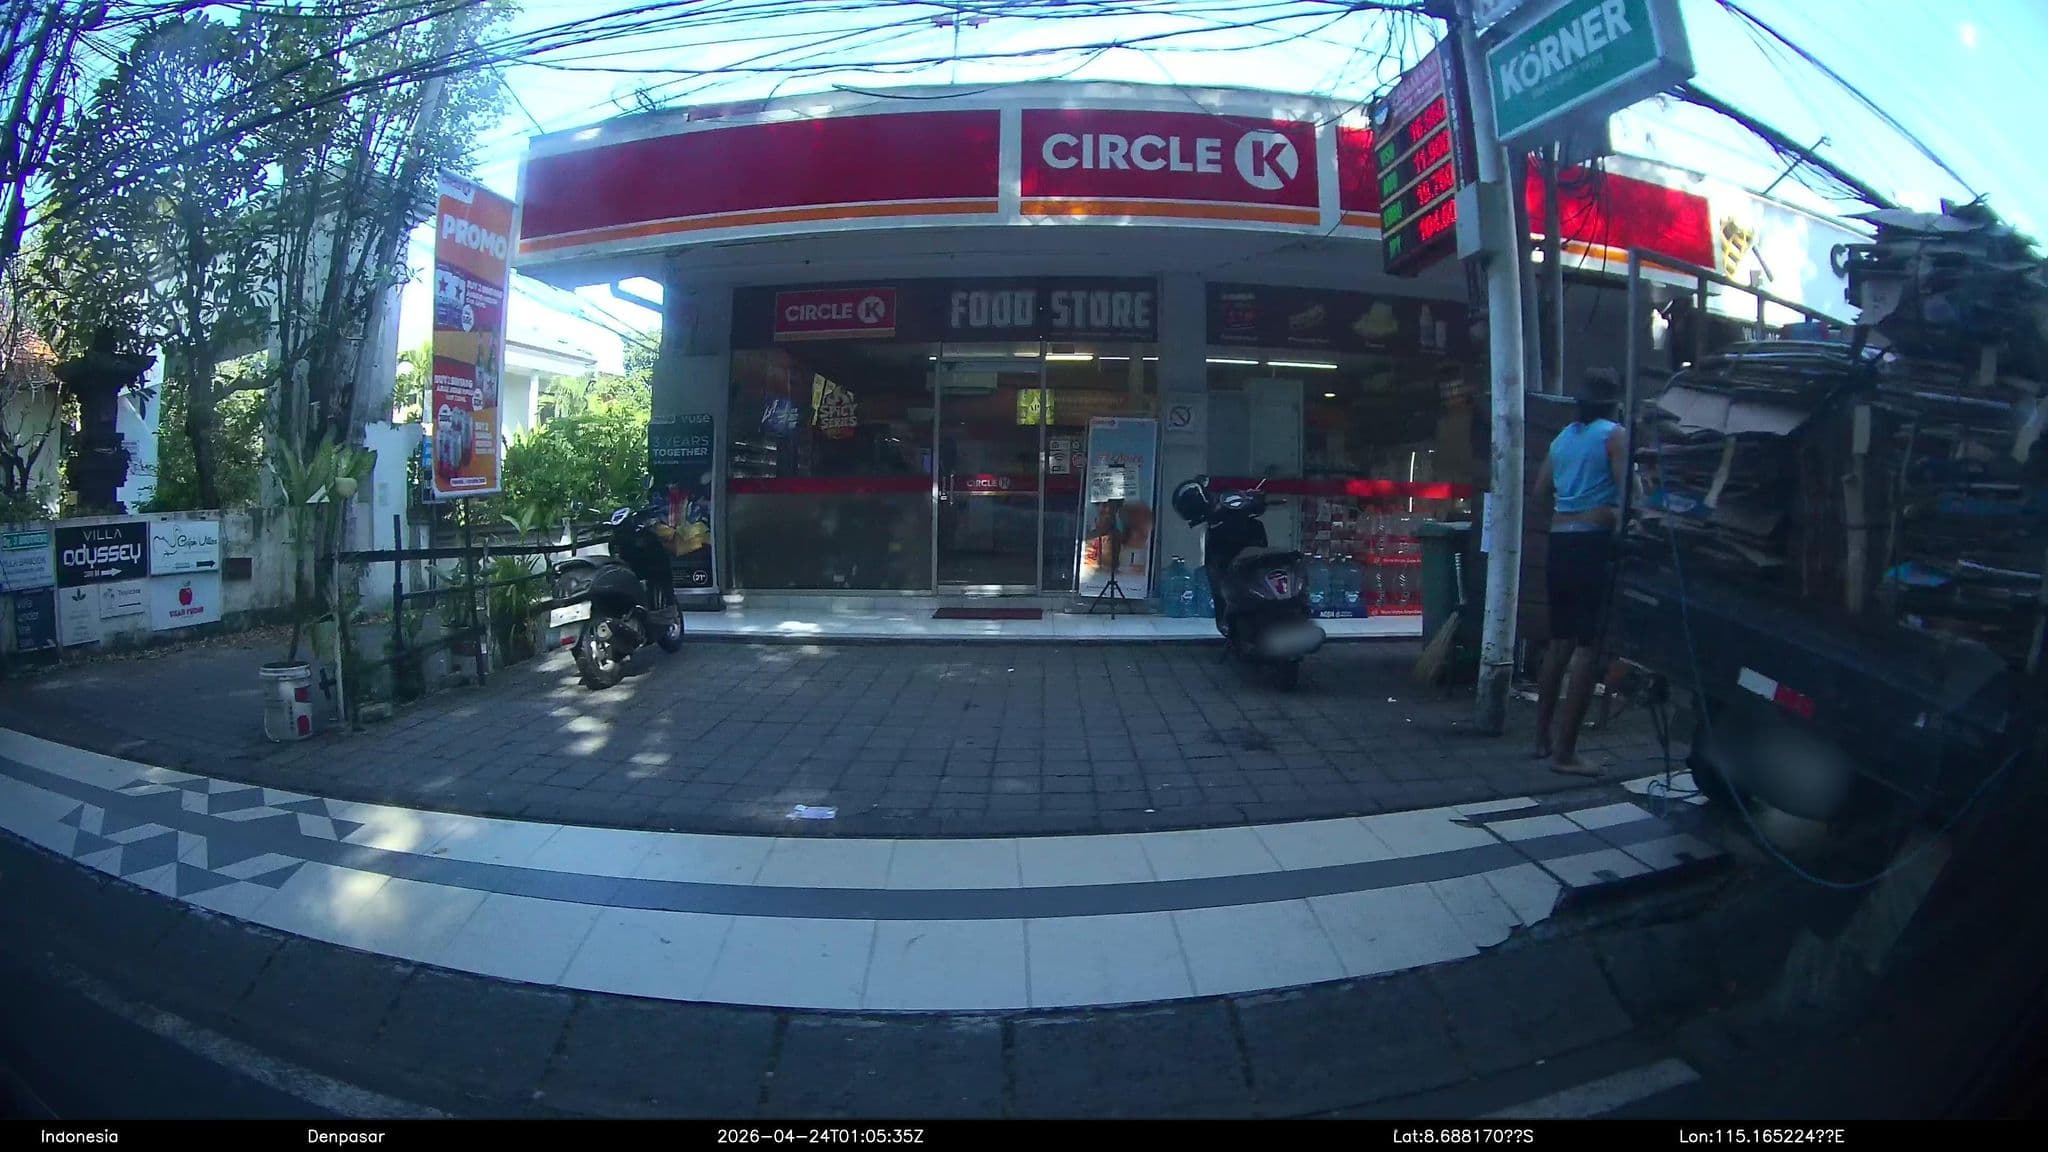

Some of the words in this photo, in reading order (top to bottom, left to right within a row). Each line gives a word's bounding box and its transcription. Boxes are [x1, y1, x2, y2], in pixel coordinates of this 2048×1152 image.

[1500, 0, 1632, 101] KÖRNER
[1042, 133, 1222, 173] CIRCLE
[1243, 131, 1298, 190] K
[442, 213, 507, 260] PROMO
[785, 303, 853, 322] CIRCLE
[862, 297, 885, 323] K
[951, 291, 1036, 328] FOOD
[1051, 291, 1152, 328] STORE
[653, 447, 709, 457] TOGETHER
[664, 435, 709, 447] YEARS
[967, 479, 998, 487] CIRCLE
[82, 529, 122, 541] VILLA
